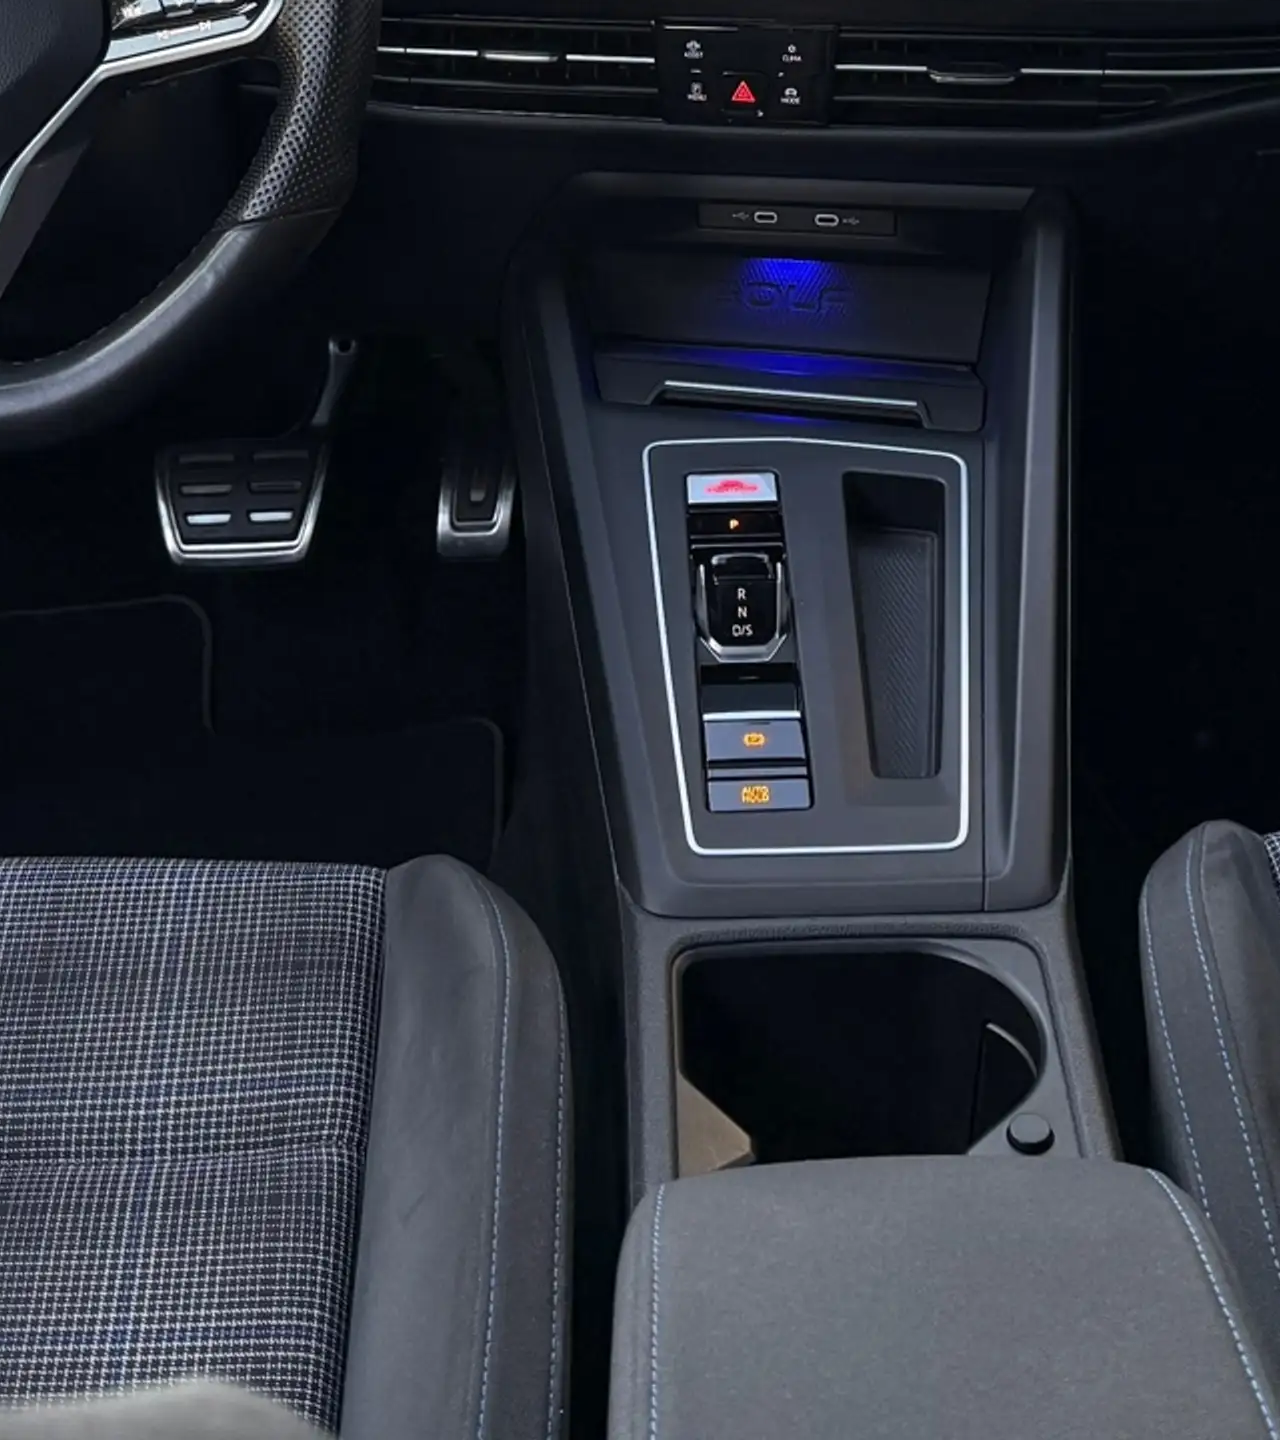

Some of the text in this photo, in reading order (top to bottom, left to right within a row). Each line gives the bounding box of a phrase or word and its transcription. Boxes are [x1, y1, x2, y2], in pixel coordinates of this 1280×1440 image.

[729, 518, 740, 530] P
[737, 587, 747, 600] R
[737, 606, 748, 618] N
[731, 624, 754, 638] D/S
